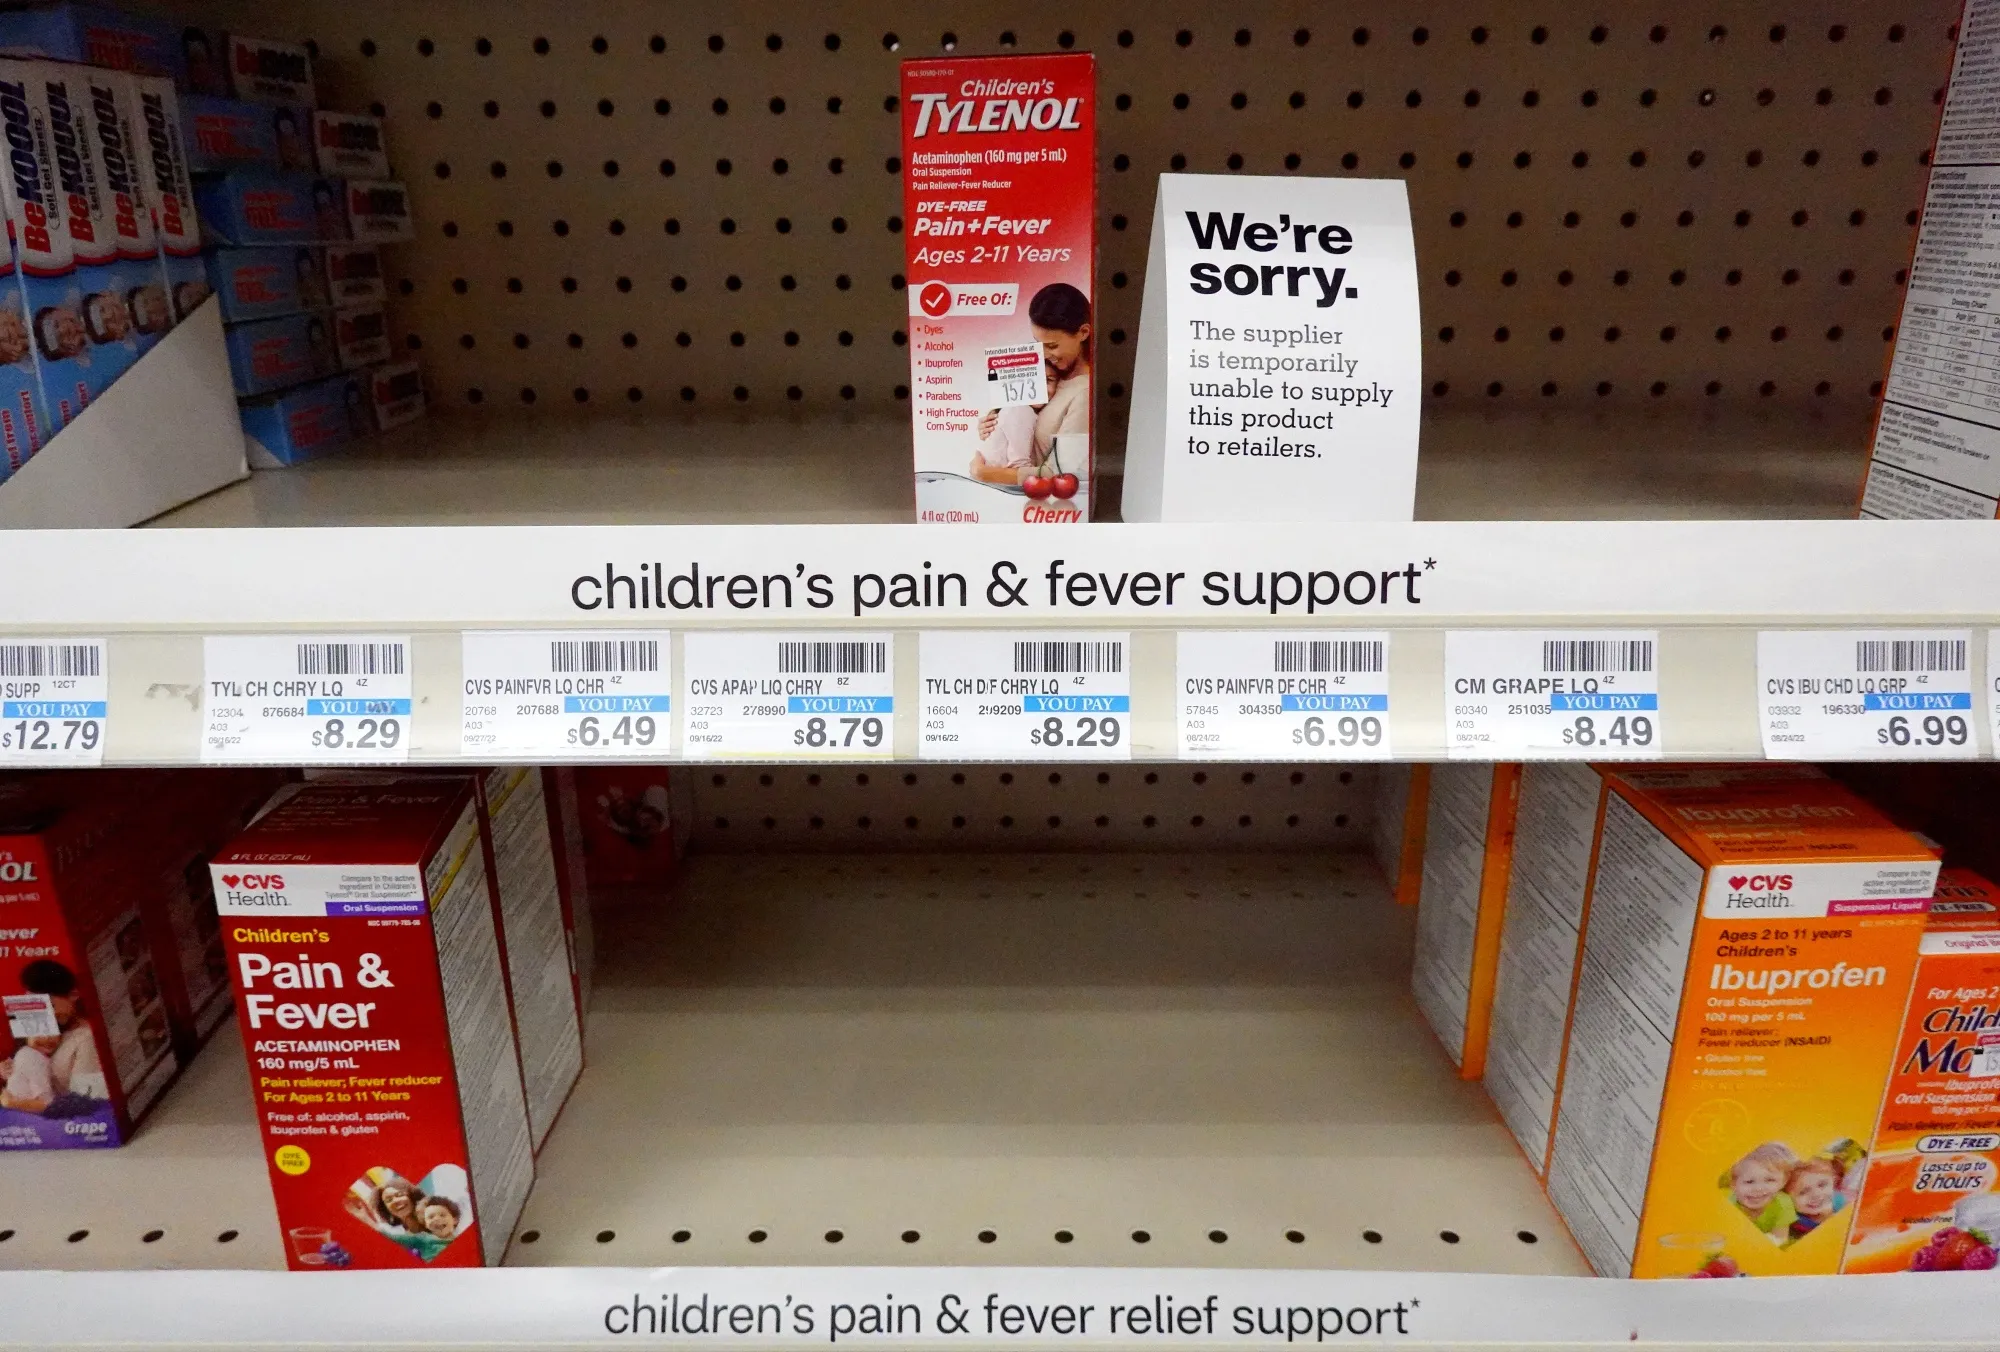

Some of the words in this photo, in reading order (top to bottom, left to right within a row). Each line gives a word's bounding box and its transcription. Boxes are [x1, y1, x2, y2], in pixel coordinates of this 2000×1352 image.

[961, 79, 1054, 97] Children's
[910, 93, 1081, 138] TYLENOL
[912, 151, 982, 165] Acetaminophen
[985, 150, 1004, 165] (160
[1007, 152, 1021, 164] mg
[1024, 151, 1038, 164] per
[1041, 151, 1047, 161] 5
[1049, 148, 1067, 163] mL)
[912, 168, 928, 177] Oral
[929, 167, 971, 178] Suspension
[917, 200, 987, 213] DYE-FREE
[913, 216, 1051, 236] Pain+Fever
[1185, 211, 1353, 255] We're
[913, 247, 965, 267] Ages
[970, 246, 1010, 263] 2-11
[1016, 245, 1071, 262] Years
[1190, 263, 1358, 308] sorry.
[957, 294, 988, 306] Free
[991, 292, 1012, 305] Of:
[924, 325, 944, 335] Dyes
[1190, 320, 1236, 341] The
[1244, 324, 1343, 348] supplier
[925, 342, 954, 351] Alcohol
[925, 359, 963, 369] Ibuprofen
[1189, 349, 1209, 369] is
[1218, 350, 1359, 378] temporarily
[926, 375, 952, 386] Aspirin
[926, 392, 961, 401] Parabens
[1190, 378, 1273, 399] unable
[1282, 381, 1303, 400] to
[1311, 382, 1393, 407] supply
[926, 408, 945, 418] High
[946, 408, 978, 417] Fructose
[1189, 405, 1233, 426] this
[1241, 408, 1333, 432] product
[927, 422, 946, 431] Corn
[947, 421, 968, 433] Syrup
[1188, 436, 1209, 455] to
[1217, 436, 1322, 458] retailers.
[947, 511, 962, 523] (120
[964, 510, 979, 523] mL)
[1023, 506, 1082, 523] Cherry
[572, 563, 833, 610] children's
[854, 561, 966, 616] pain
[987, 561, 1028, 607] &
[1046, 560, 1184, 606] fever
[6, 683, 40, 698] SUPP
[212, 682, 241, 697] TYL
[246, 681, 268, 697] CH
[273, 681, 317, 697] CHRY
[322, 681, 343, 697] LQ
[356, 679, 368, 687] 4Z
[465, 679, 491, 695] CVS
[496, 679, 551, 694] PAINFVR
[556, 679, 572, 694] LQ
[576, 679, 604, 694] CHR
[610, 676, 622, 684] 4Z
[691, 680, 717, 695] CVS
[761, 680, 782, 695] LIQ
[786, 680, 822, 695] CHRY
[926, 679, 950, 694] TYL
[954, 679, 972, 694] CH
[1000, 679, 1037, 694] CHRY
[1042, 679, 1059, 695] LQ
[1073, 677, 1085, 685] 4Z
[1186, 679, 1212, 694] CVS
[1217, 679, 1274, 694] PAINFVR
[1278, 679, 1295, 694] DF
[1299, 679, 1327, 694] CHR
[1454, 678, 1485, 694] CM
[1492, 678, 1564, 694] GRAPE
[1572, 678, 1598, 694] LQ
[1603, 676, 1615, 684] 4Z
[1767, 679, 1794, 694] CVS
[1799, 679, 1820, 694] IBU
[1824, 679, 1853, 694] CHD
[1857, 679, 1874, 694] LQ
[1879, 678, 1907, 694] GRP
[1037, 698, 1077, 711] YOU
[1083, 698, 1114, 711] PAY
[1564, 696, 1603, 708] YOU
[1610, 696, 1641, 708] PAY
[17, 704, 55, 716] YOU
[60, 704, 91, 716] PAY
[263, 707, 305, 717] 876684
[465, 706, 497, 716] 20768
[517, 705, 559, 715] 207688
[690, 707, 723, 716] 32723
[743, 706, 786, 716] 278990
[927, 706, 958, 715] 16604
[1186, 706, 1218, 715] 57845
[1239, 705, 1282, 715] 304350
[1455, 706, 1488, 715] 60340
[1508, 705, 1551, 715] 251035
[1822, 705, 1866, 715] 196330
[2, 720, 99, 750] $12.79
[312, 718, 400, 749] $8.29
[567, 716, 656, 746] $6.49
[794, 717, 884, 747] $8.79
[1031, 717, 1120, 747] $8.29
[1292, 716, 1382, 746] $6.99
[1562, 716, 1653, 746] $8.49
[1878, 716, 1968, 746] $6.99
[243, 874, 285, 889] CVS
[1750, 874, 1793, 891] CVS
[227, 891, 288, 906] Health
[1726, 893, 1790, 909] Health
[1892, 902, 1922, 911] Liquid
[233, 928, 330, 943] Children's
[1719, 929, 1757, 943] Ages
[1761, 929, 1771, 939] 2
[1775, 930, 1788, 939] to
[1794, 929, 1806, 939] 11
[1812, 929, 1852, 941] years
[1717, 945, 1797, 957] Children's
[238, 953, 343, 989] Pain
[356, 952, 395, 988] &
[1710, 962, 1886, 996] Ibuprofen
[245, 994, 376, 1030] Fever
[254, 1040, 400, 1052] ACETAMINOPHEN
[258, 1058, 284, 1069] 160
[289, 1058, 330, 1072] mg/5
[334, 1058, 360, 1069] mL
[260, 1077, 290, 1087] Pain
[293, 1077, 346, 1088] reliever;
[350, 1076, 386, 1086] Fever
[390, 1075, 442, 1086] reducer
[264, 1092, 286, 1102] For
[268, 1112, 294, 1122] Free
[297, 1112, 312, 1122] of:
[315, 1112, 362, 1122] alcohol,
[365, 1111, 410, 1122] aspirin,
[65, 1121, 107, 1135] Grape
[1922, 1162, 1953, 1172] Lasts
[1956, 1163, 1971, 1173] up
[1916, 1174, 1931, 1190] 8
[1932, 1174, 1982, 1189] hours
[605, 1295, 813, 1333] children's
[831, 1294, 920, 1342] pain
[937, 1295, 969, 1333] &
[984, 1294, 1094, 1334] fever
[1111, 1295, 1217, 1334] relief
